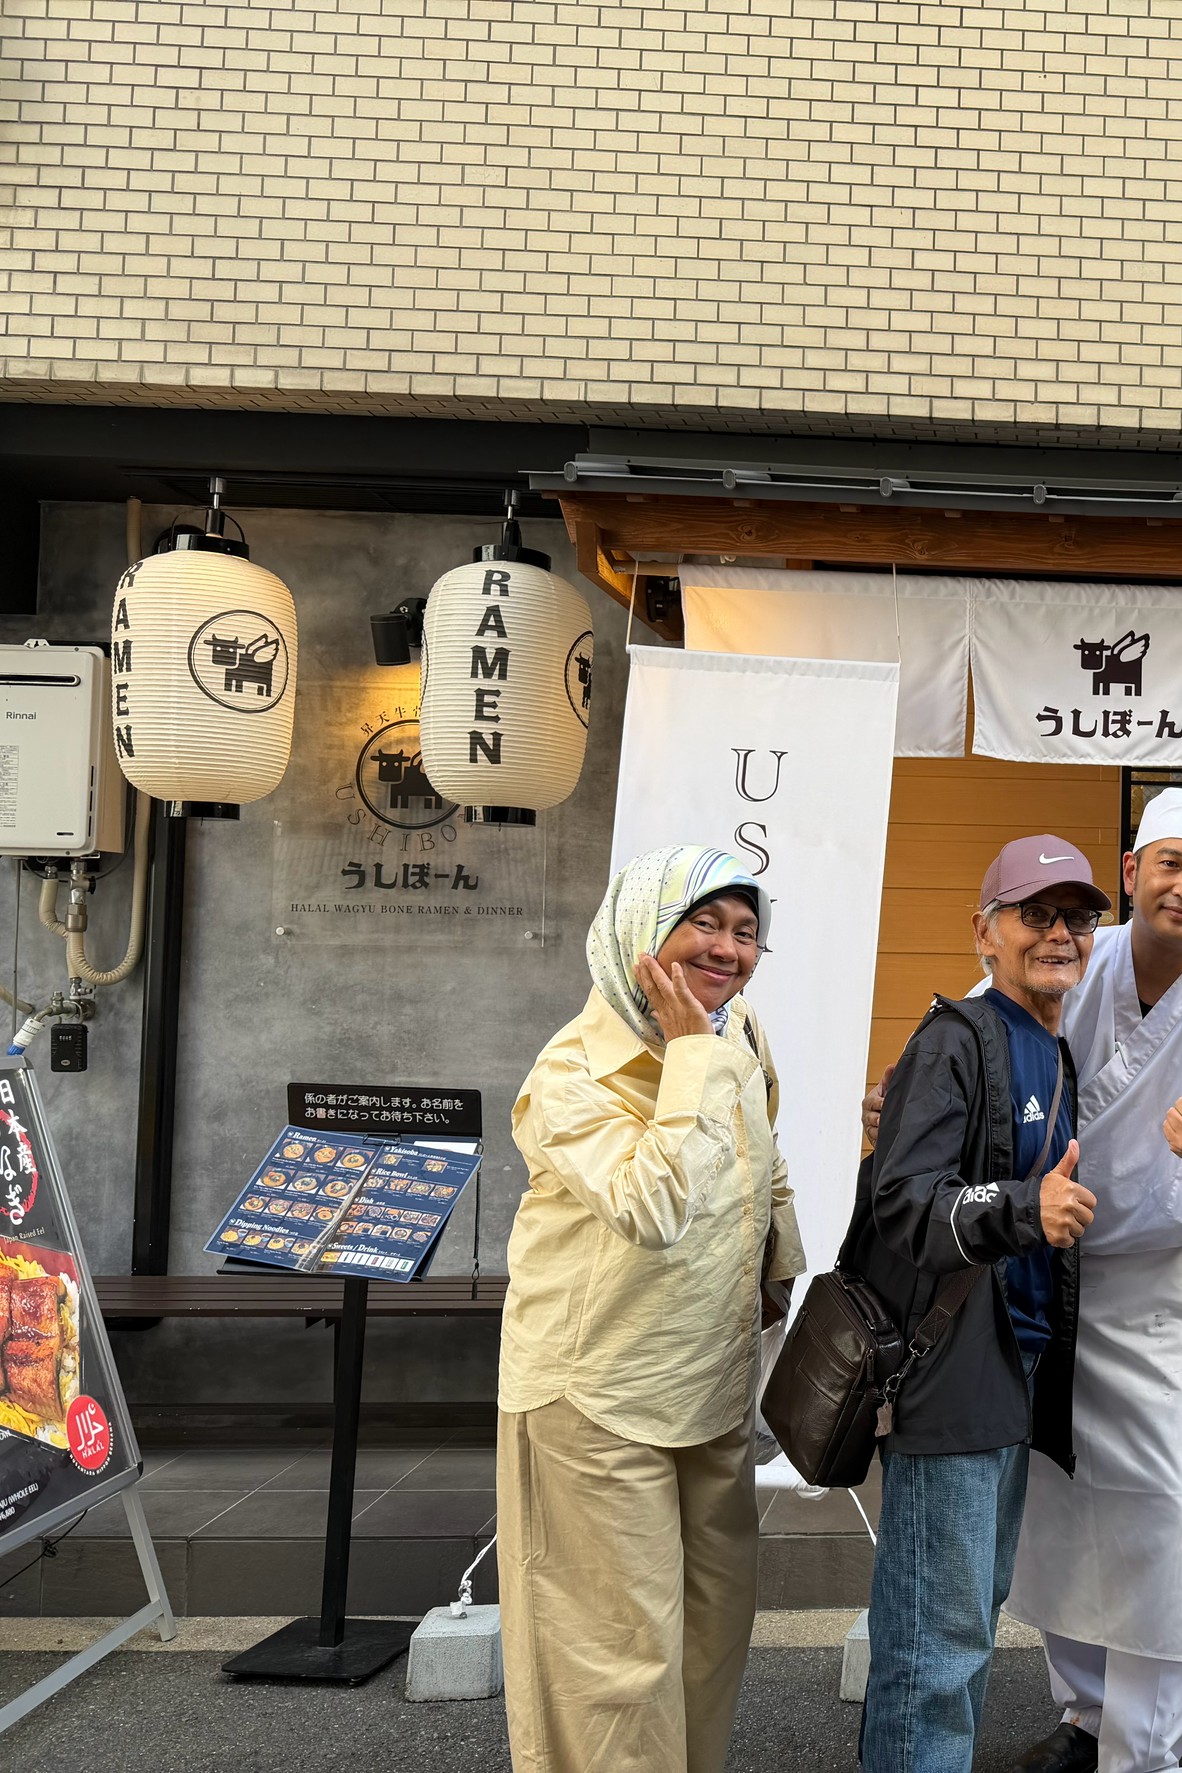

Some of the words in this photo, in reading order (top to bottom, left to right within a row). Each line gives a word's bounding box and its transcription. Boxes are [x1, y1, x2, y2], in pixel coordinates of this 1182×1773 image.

[113, 562, 143, 758] RAMEN
[467, 569, 512, 765] RAMEN
[6, 711, 37, 720] Rinnai
[335, 783, 465, 852] USHIBO
[340, 861, 479, 891] うしぼーん
[291, 904, 329, 913] HALAL
[334, 904, 376, 913] WAGYU
[381, 905, 413, 914] BONE
[417, 905, 459, 915] RAMEN
[463, 906, 472, 915] &
[477, 907, 523, 916] DINNER
[304, 1093, 464, 1110] 係の者がご案内します。お名前を
[305, 1107, 450, 1124] お書きになってお待ち下さい。
[0, 1079, 37, 1175] 日本産
[292, 1131, 318, 1142] Ramen
[389, 1145, 418, 1156] Yakisoba
[375, 1168, 392, 1177] Rice
[390, 1170, 408, 1179] Bowl
[359, 1196, 374, 1205] Dish
[233, 1218, 262, 1232] Dipping
[260, 1224, 290, 1235] Noodles
[332, 1242, 355, 1251] Sweets
[356, 1244, 379, 1253] Drink
[81, 1440, 105, 1459] HALAL
